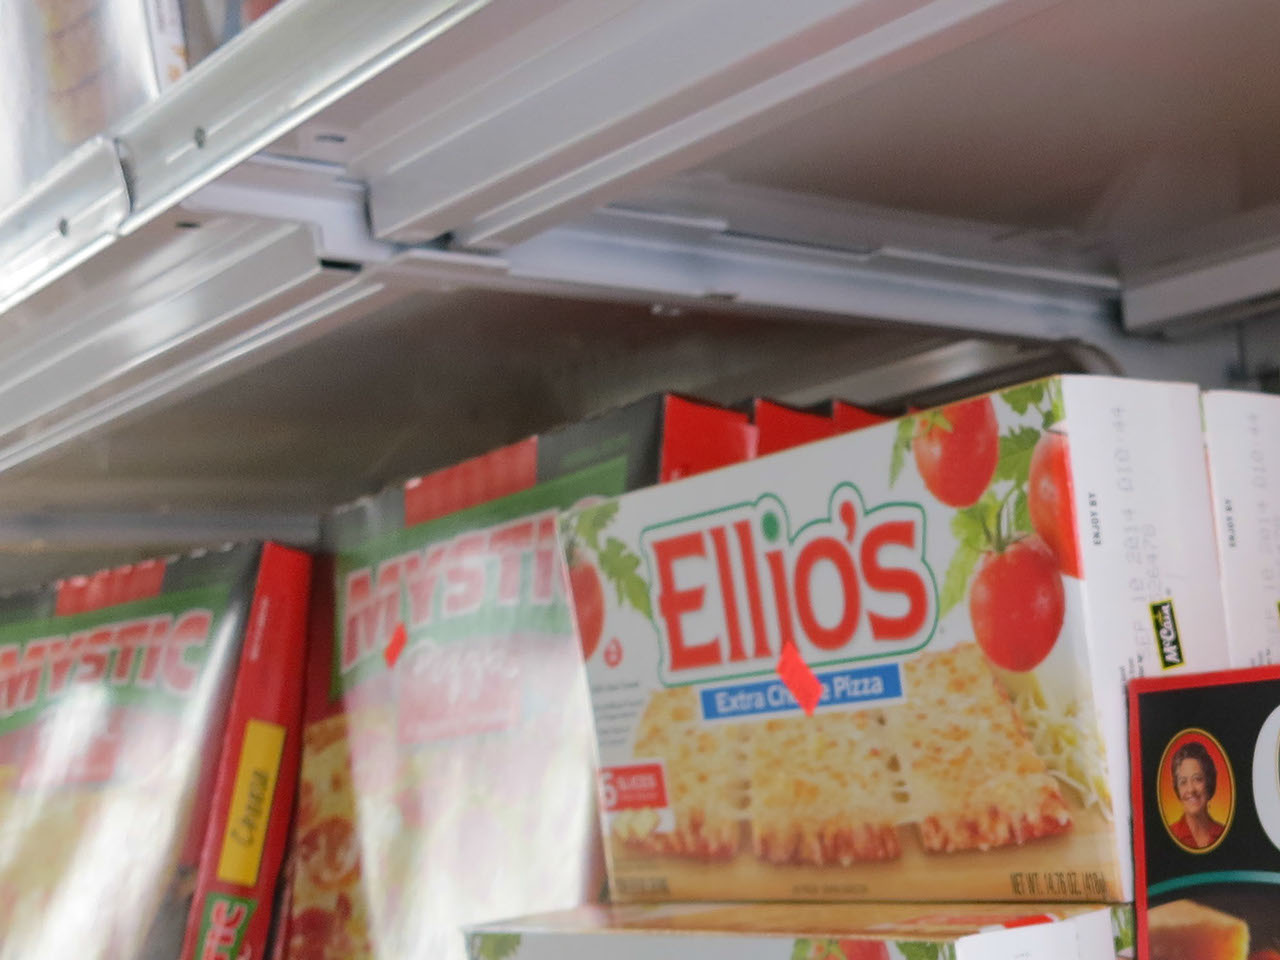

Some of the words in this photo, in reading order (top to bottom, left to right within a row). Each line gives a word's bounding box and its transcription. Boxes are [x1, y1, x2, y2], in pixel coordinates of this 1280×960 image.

[1088, 492, 1097, 508] BY
[1090, 511, 1102, 547] ENJOY
[342, 510, 562, 675] MYSTI
[651, 499, 929, 673] Ellio's
[1160, 603, 1181, 666] McCain
[715, 690, 765, 714] Extra
[767, 682, 831, 708] Che
[833, 675, 884, 700] Pizza
